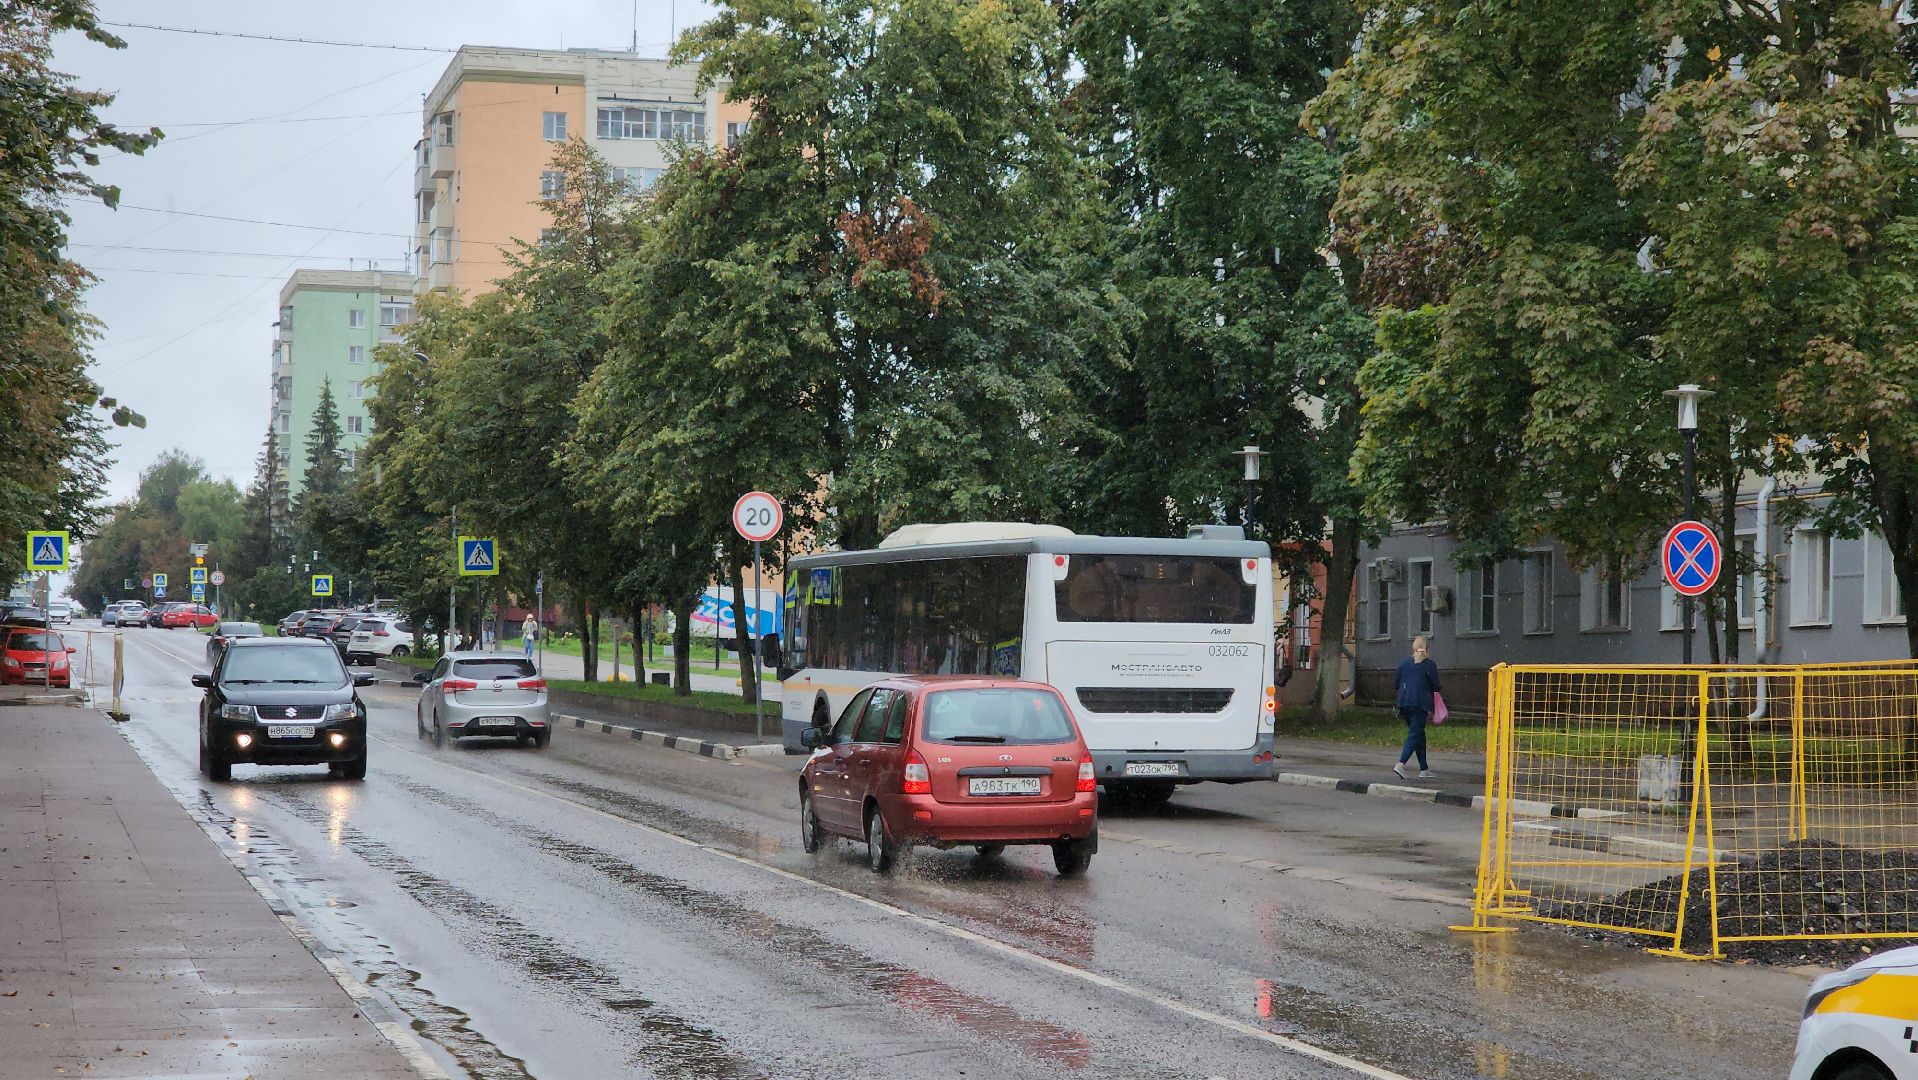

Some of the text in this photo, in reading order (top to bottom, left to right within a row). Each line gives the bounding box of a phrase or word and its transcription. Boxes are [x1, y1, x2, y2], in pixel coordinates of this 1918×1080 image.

[746, 507, 771, 526] 20
[1208, 645, 1249, 657] 032062
[1129, 764, 1176, 774] Т023ОК 790
[974, 779, 1037, 791] А983ТК 190
